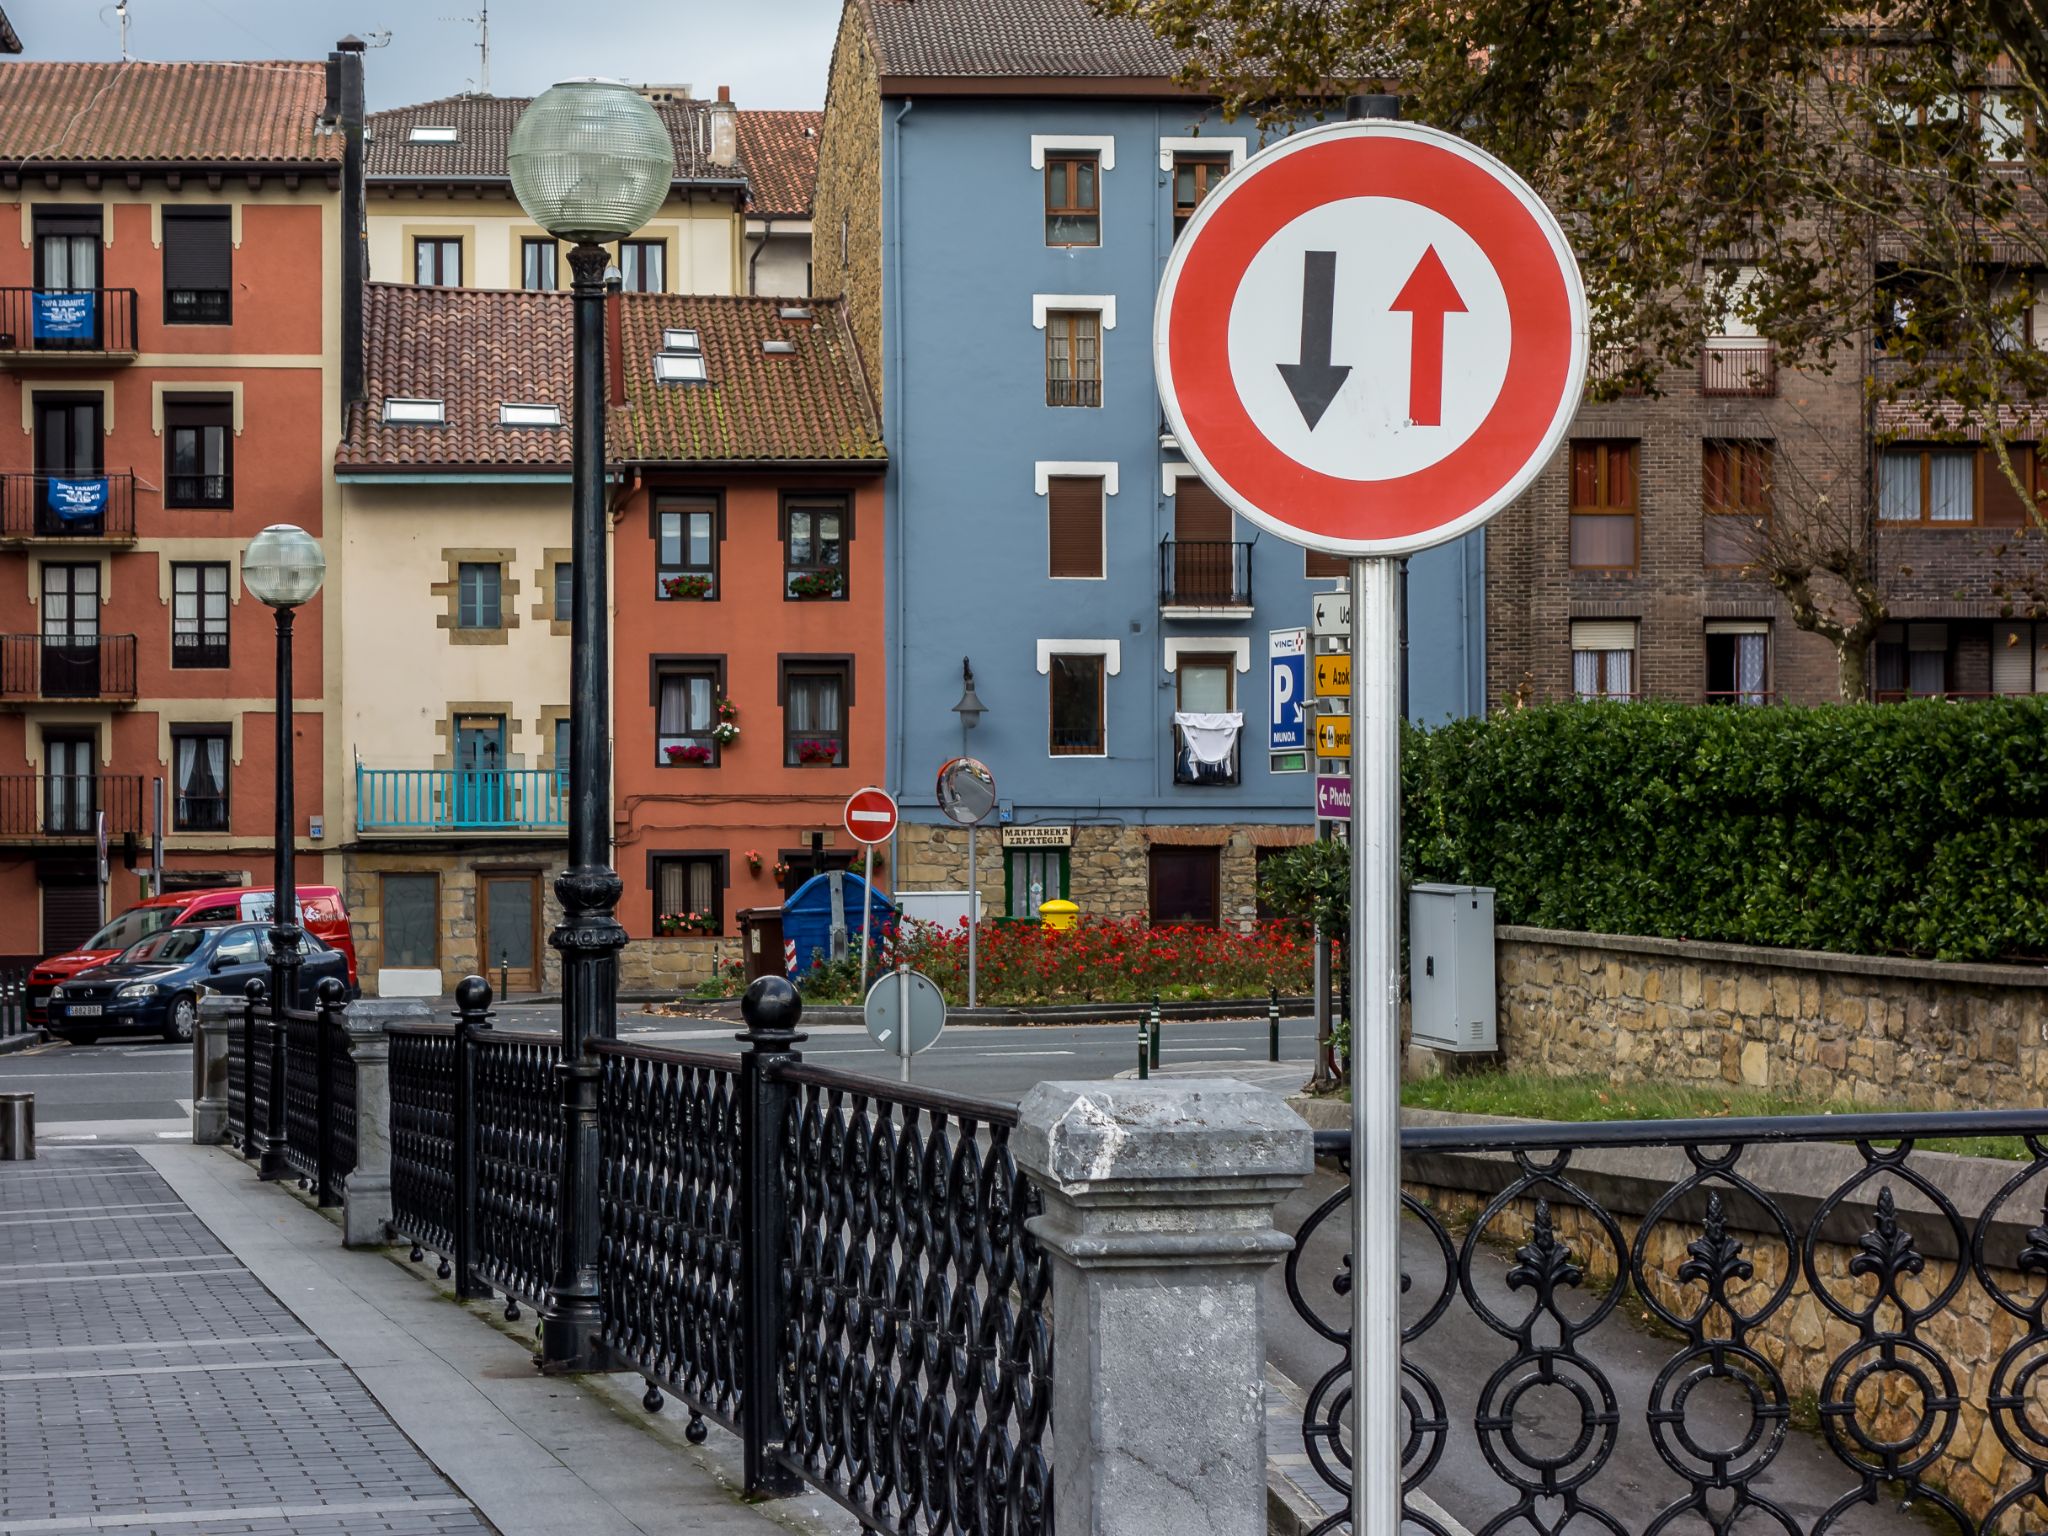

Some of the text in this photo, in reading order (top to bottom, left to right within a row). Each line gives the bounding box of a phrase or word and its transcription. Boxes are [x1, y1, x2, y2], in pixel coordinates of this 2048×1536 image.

[1274, 640, 1295, 648] VINCI
[1273, 664, 1294, 724] P
[1273, 732, 1296, 743] MUNDA
[1329, 786, 1351, 807] Photo
[1004, 828, 1069, 837] MARTIARENA
[1009, 836, 1065, 845] ZAPATEGIA
